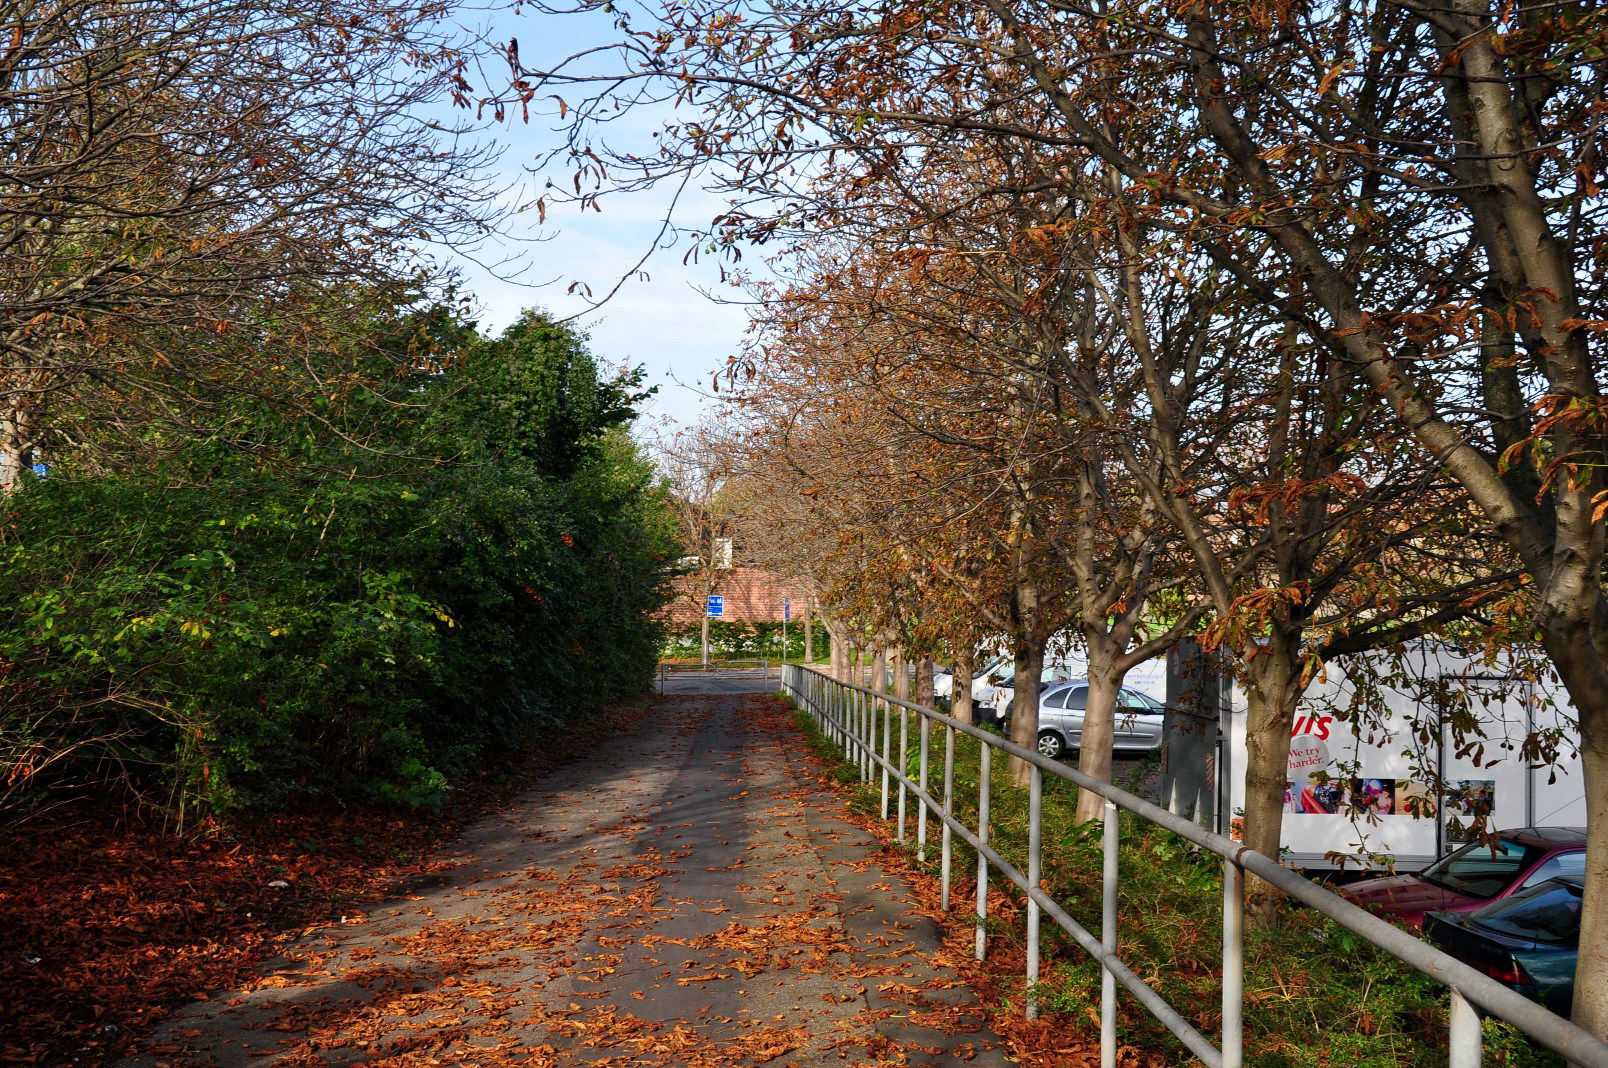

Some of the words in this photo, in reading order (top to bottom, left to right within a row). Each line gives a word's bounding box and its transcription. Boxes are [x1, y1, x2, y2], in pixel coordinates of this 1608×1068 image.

[1289, 749, 1303, 757] We
[1305, 747, 1320, 756] try
[1289, 756, 1325, 769] harder.
